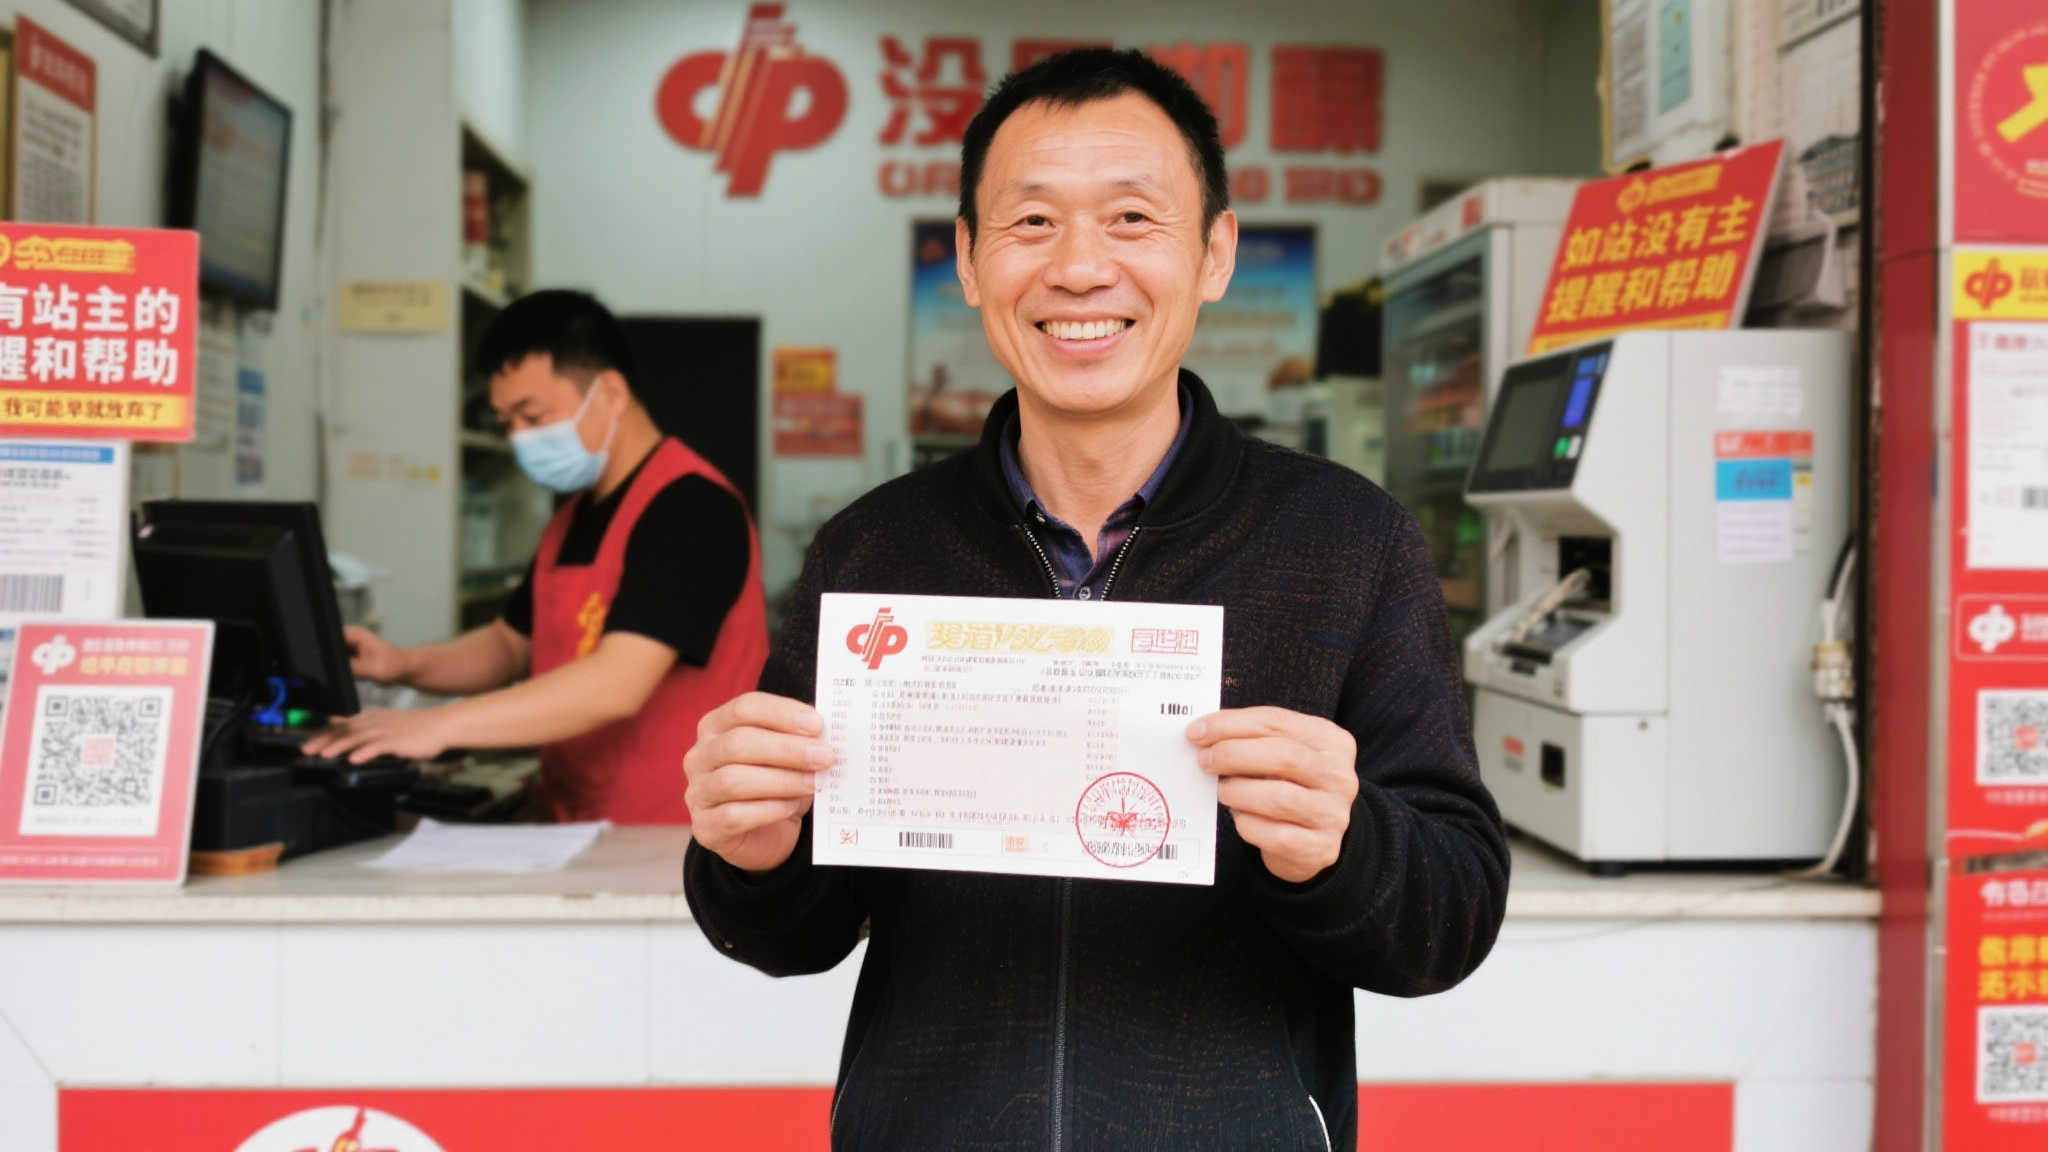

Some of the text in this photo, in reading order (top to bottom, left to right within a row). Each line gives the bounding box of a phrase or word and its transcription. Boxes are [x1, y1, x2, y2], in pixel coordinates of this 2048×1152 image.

[1545, 250, 1738, 324] 提醒和帮助
